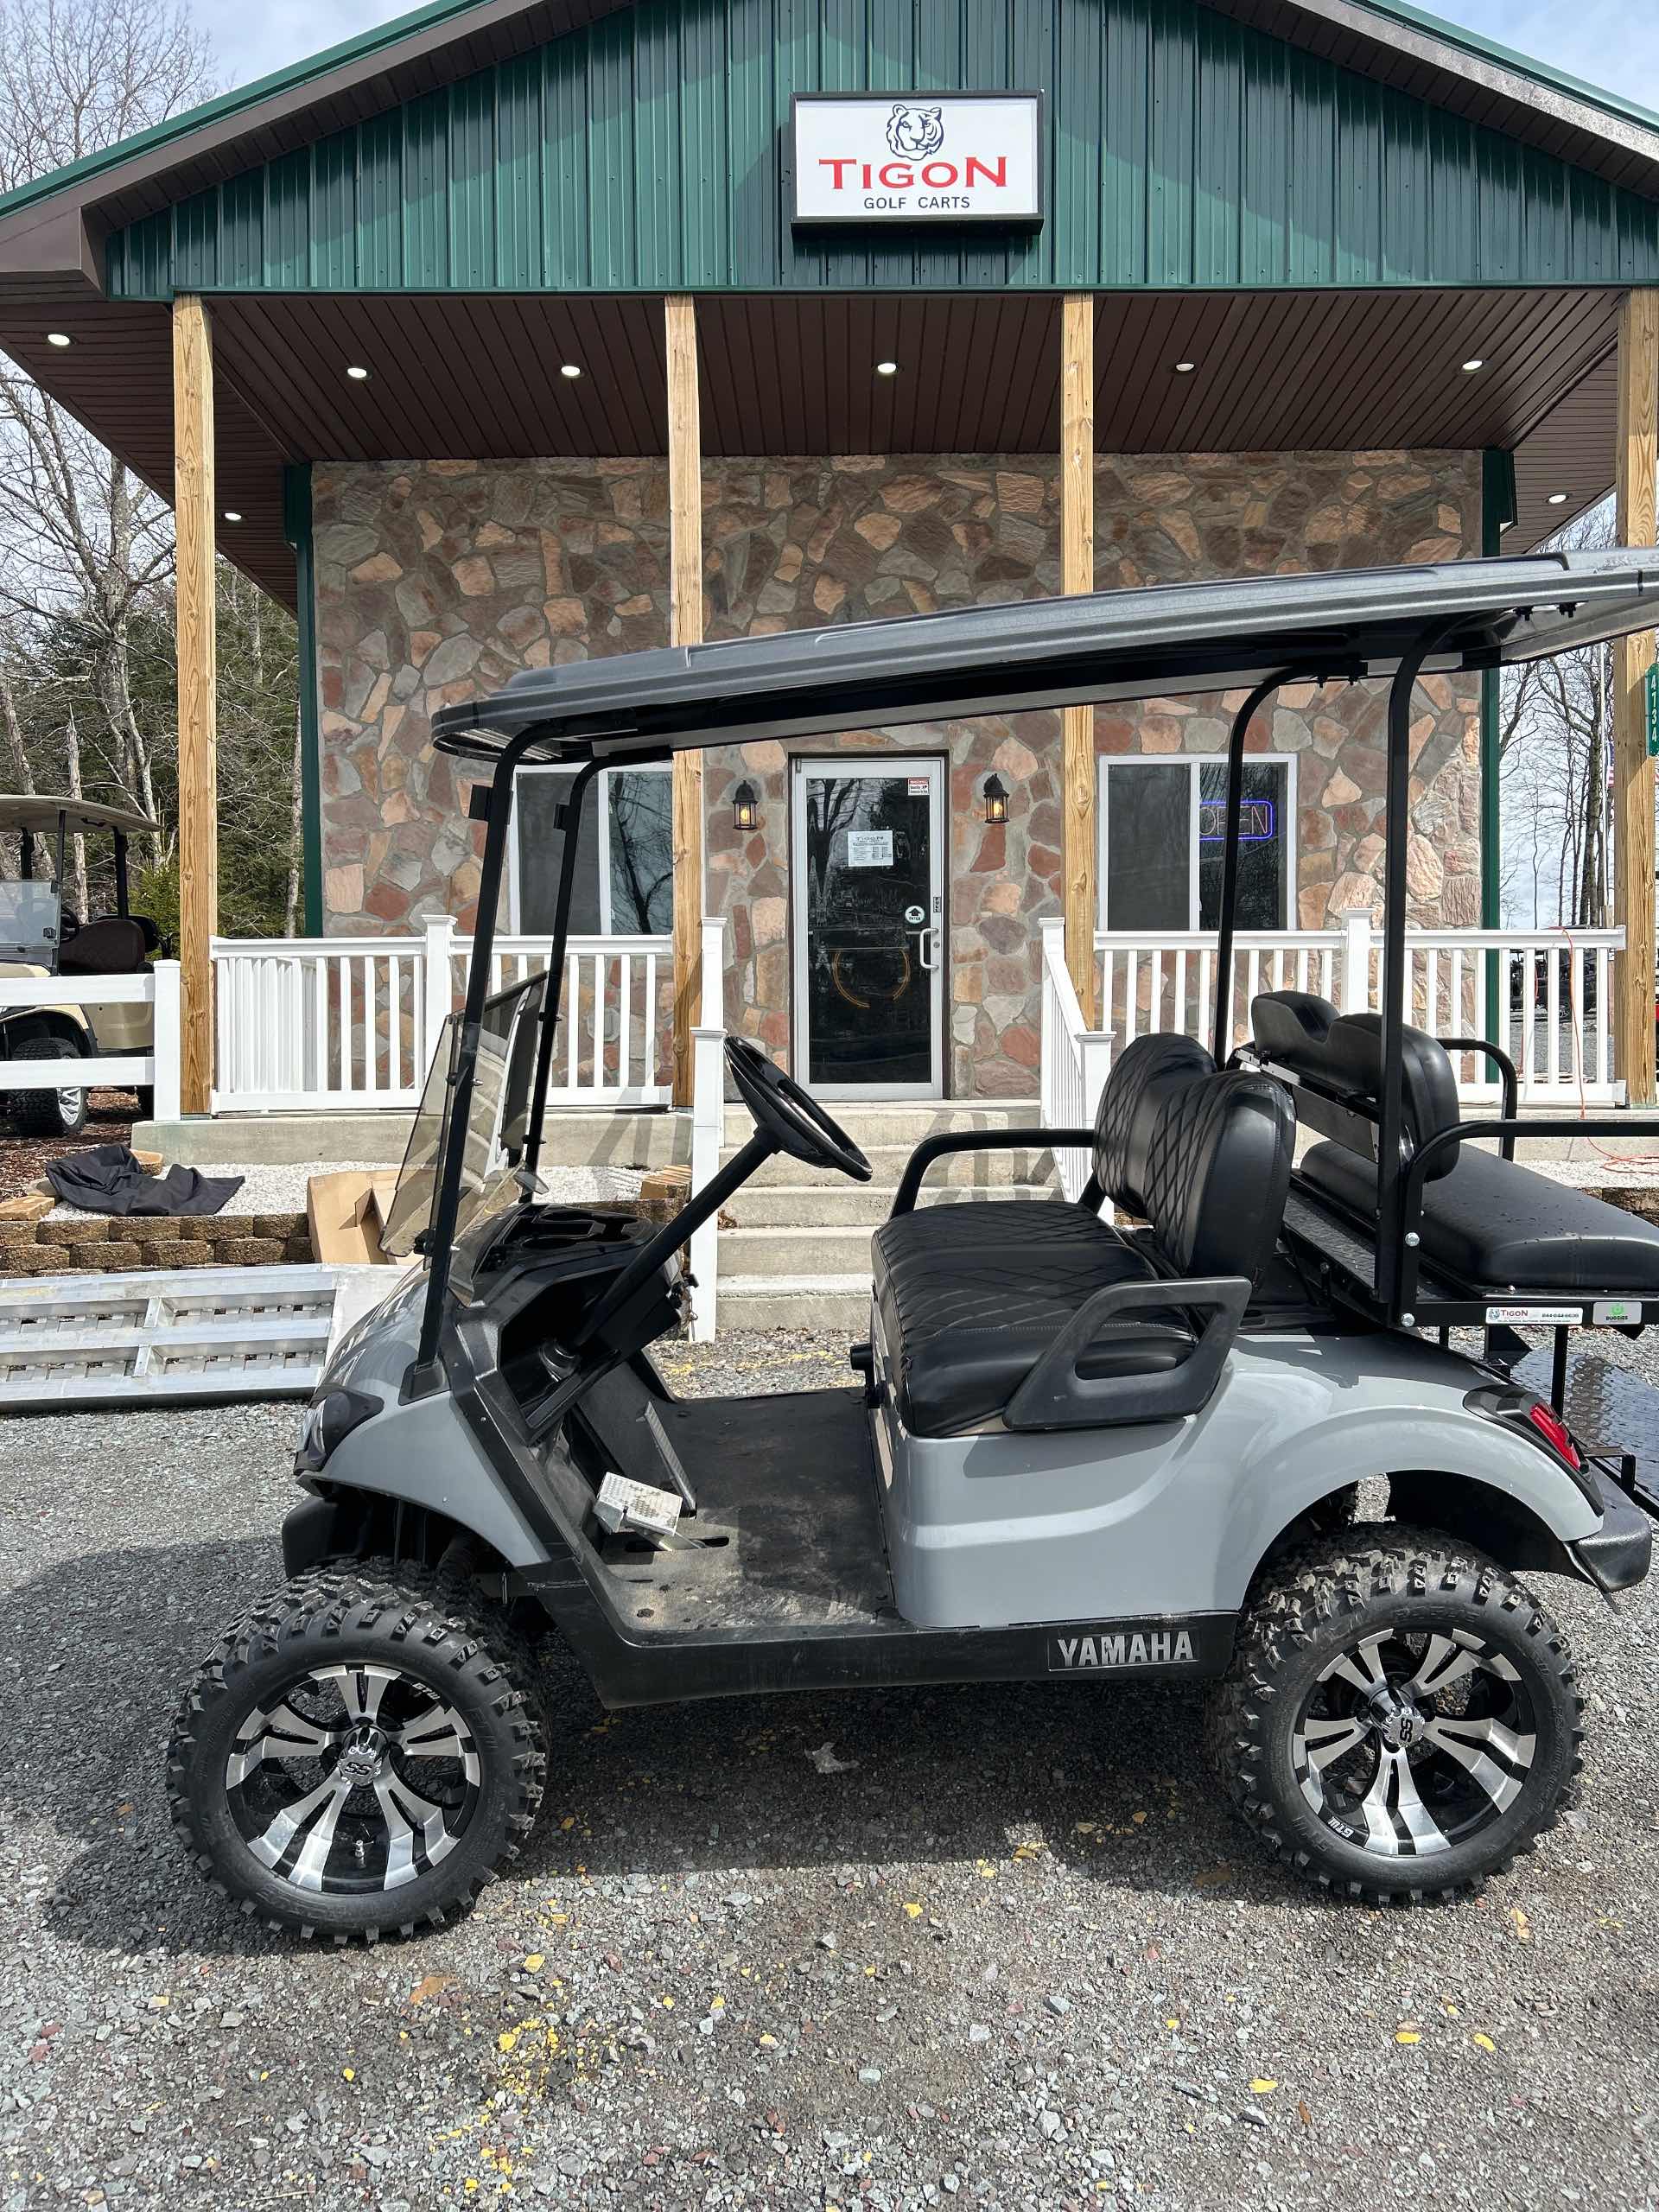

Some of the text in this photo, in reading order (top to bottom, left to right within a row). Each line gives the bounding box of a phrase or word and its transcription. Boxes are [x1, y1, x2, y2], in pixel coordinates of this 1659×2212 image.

[818, 156, 1007, 190] TIGON
[864, 196, 970, 209] GOLF CARTS
[1057, 1630, 1194, 1667] YAMAHA
